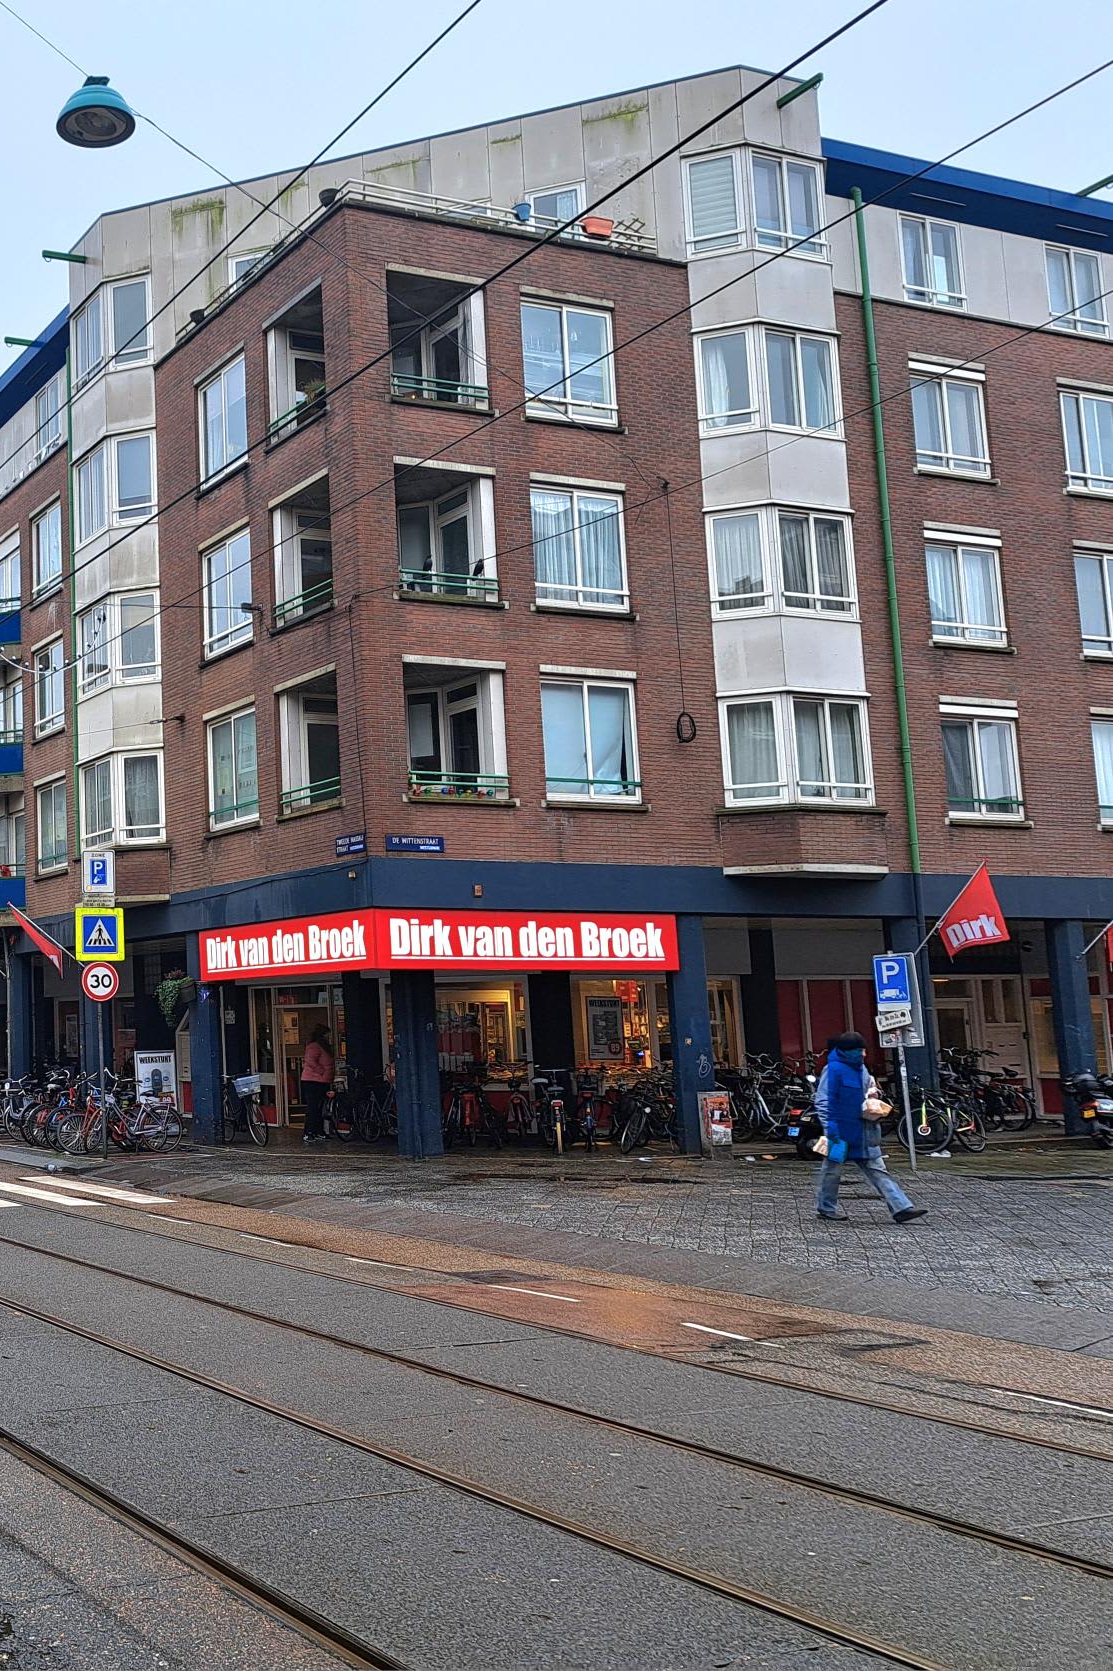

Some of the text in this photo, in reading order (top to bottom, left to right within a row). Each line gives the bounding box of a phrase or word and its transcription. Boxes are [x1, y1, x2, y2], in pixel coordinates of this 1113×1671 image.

[402, 837, 439, 845] WITTENSTRAAT
[93, 861, 103, 875] P
[389, 918, 665, 958] Dirk van den Broek
[945, 914, 1002, 948] Dirk
[206, 919, 366, 970] Dirk van den Broek
[90, 973, 113, 989] 30
[881, 961, 900, 984] P
[138, 1055, 172, 1064] WEEKSTUNT
